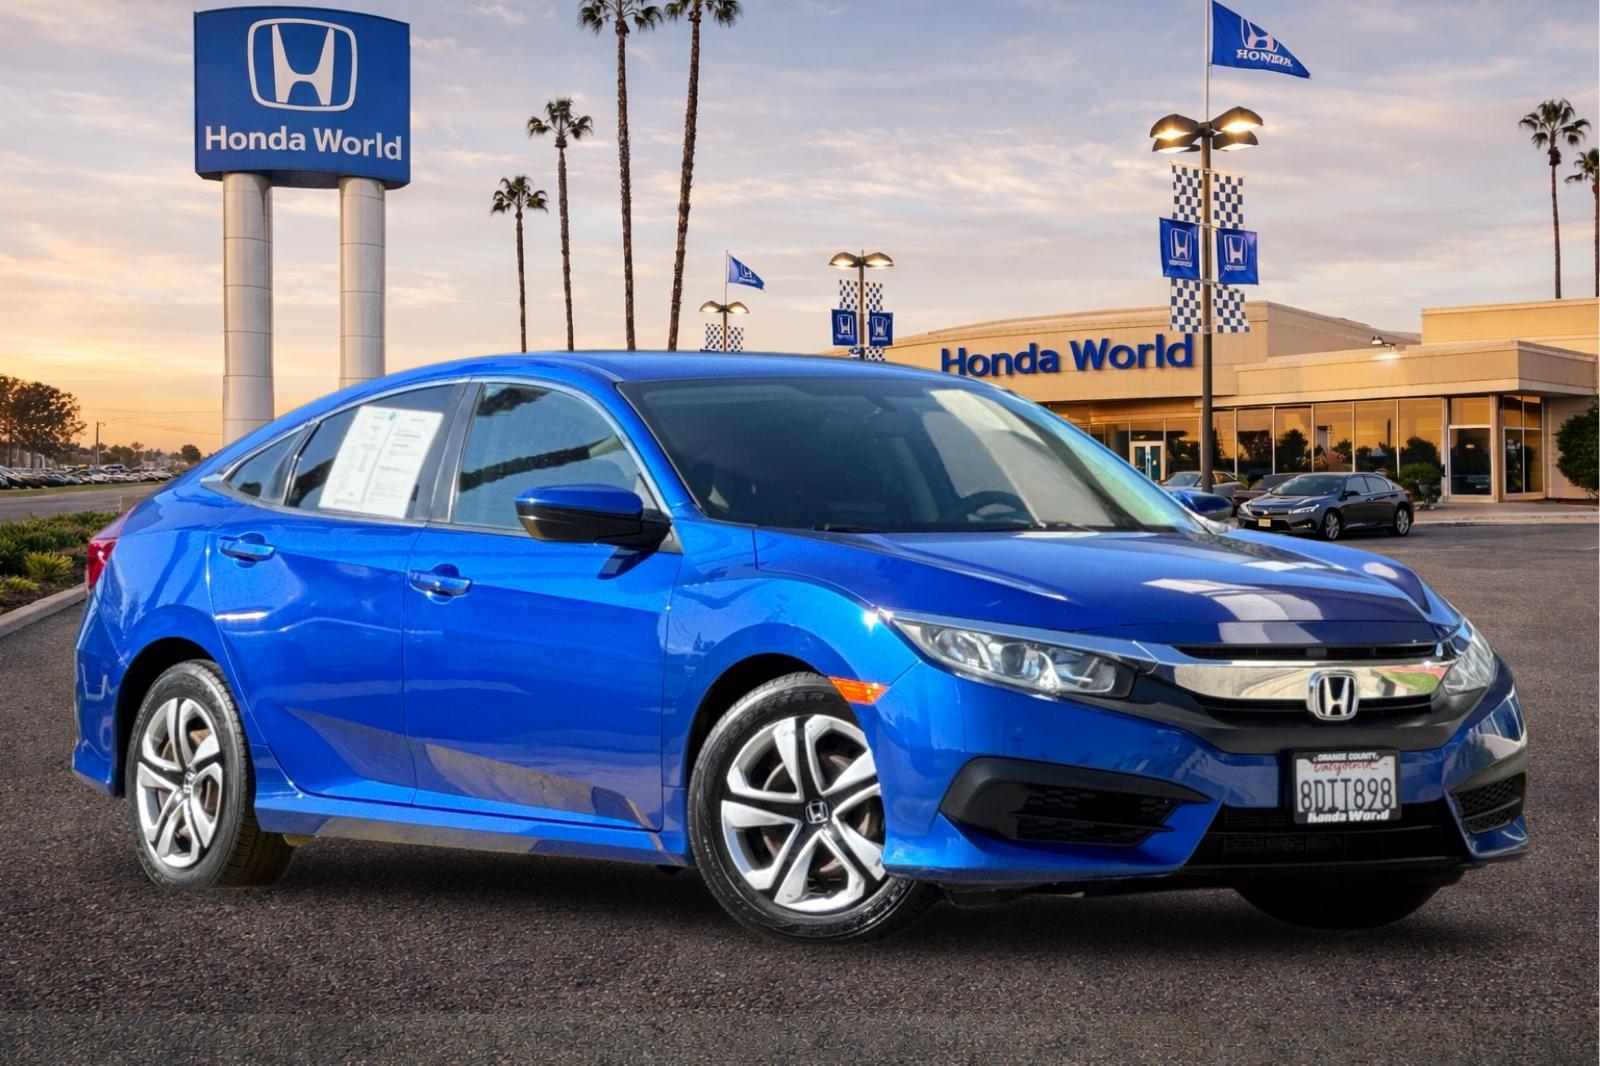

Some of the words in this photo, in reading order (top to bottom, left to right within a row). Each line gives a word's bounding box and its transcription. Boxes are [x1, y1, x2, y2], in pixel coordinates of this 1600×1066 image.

[205, 125, 306, 151] Honda
[313, 127, 402, 161] World
[941, 342, 1061, 377] Honda
[1069, 333, 1194, 371] World
[1317, 753, 1347, 762] ORANGE
[1348, 752, 1377, 761] COUNTY
[1300, 777, 1392, 812] 8DIT898
[1307, 810, 1347, 824] Honda
